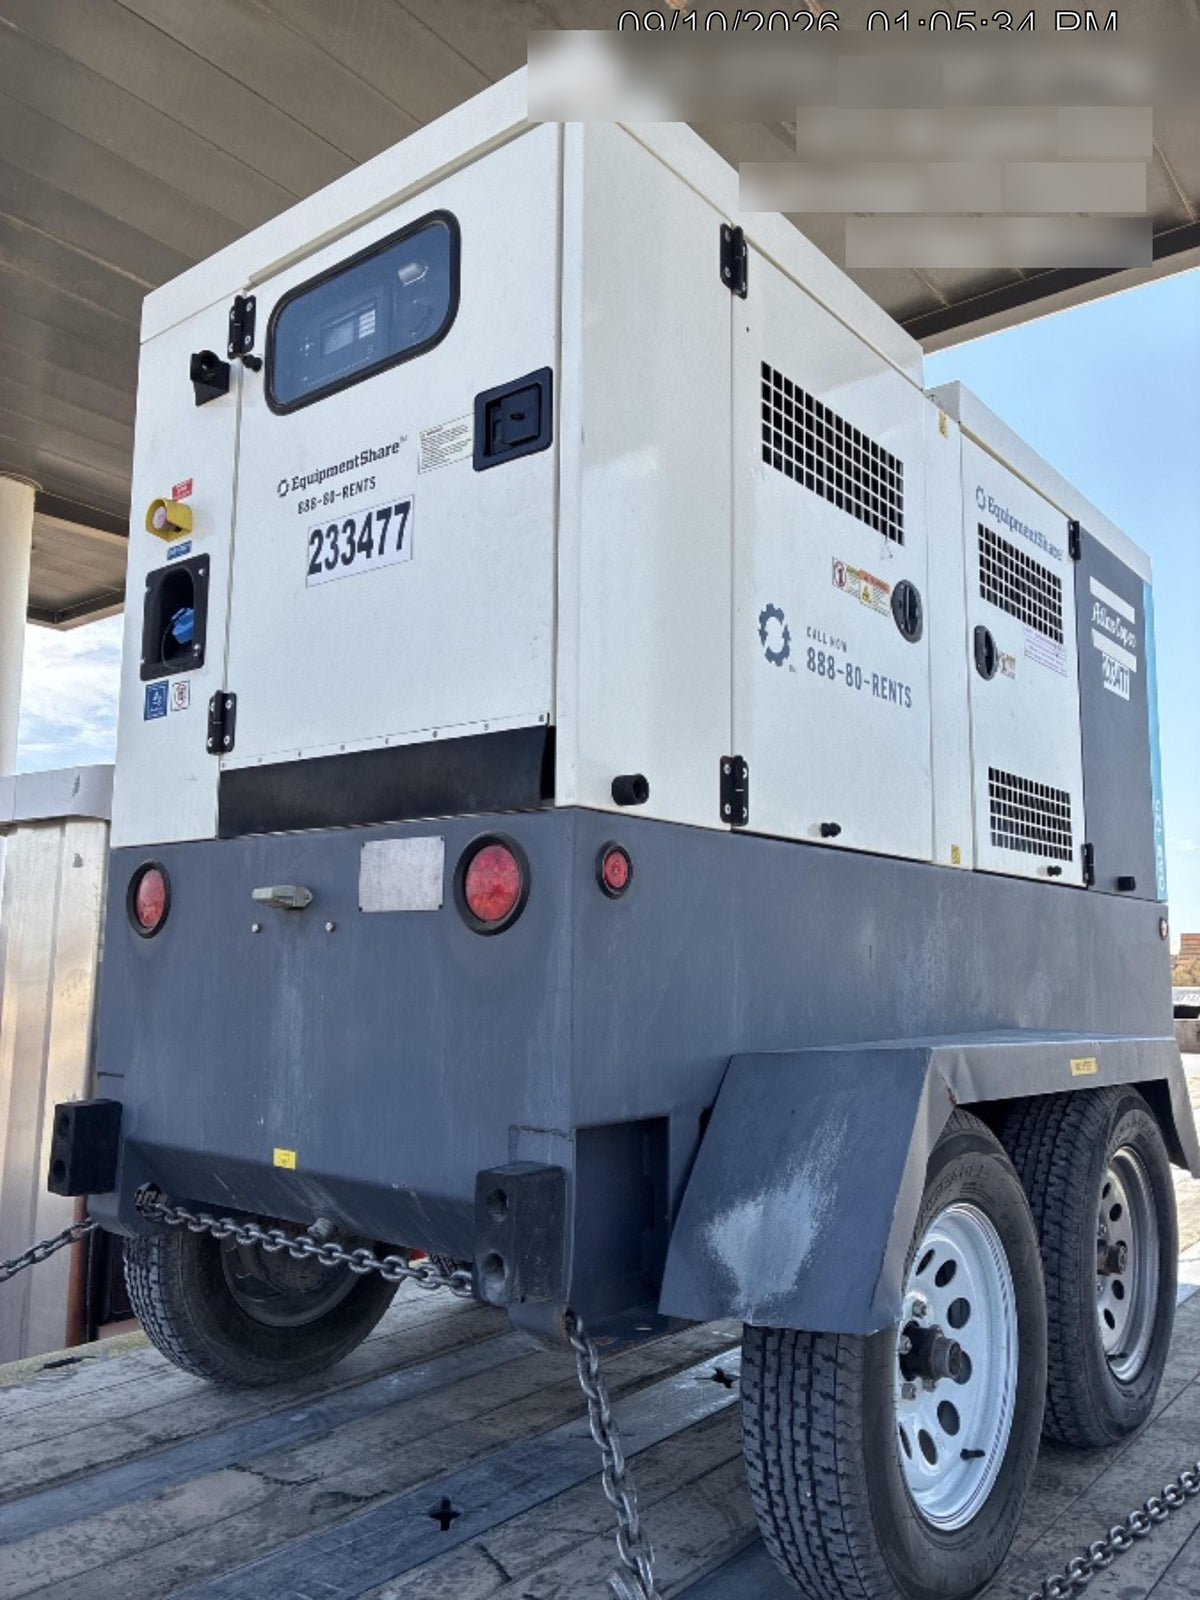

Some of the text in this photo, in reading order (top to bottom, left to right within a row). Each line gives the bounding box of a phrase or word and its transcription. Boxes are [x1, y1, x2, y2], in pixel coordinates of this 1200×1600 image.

[291, 441, 400, 491] EquipmentShare
[297, 475, 377, 515] 888-80-RENTS
[306, 500, 411, 576] 233477
[806, 626, 828, 645] CALL
[806, 646, 912, 709] 888-80-RENTS
